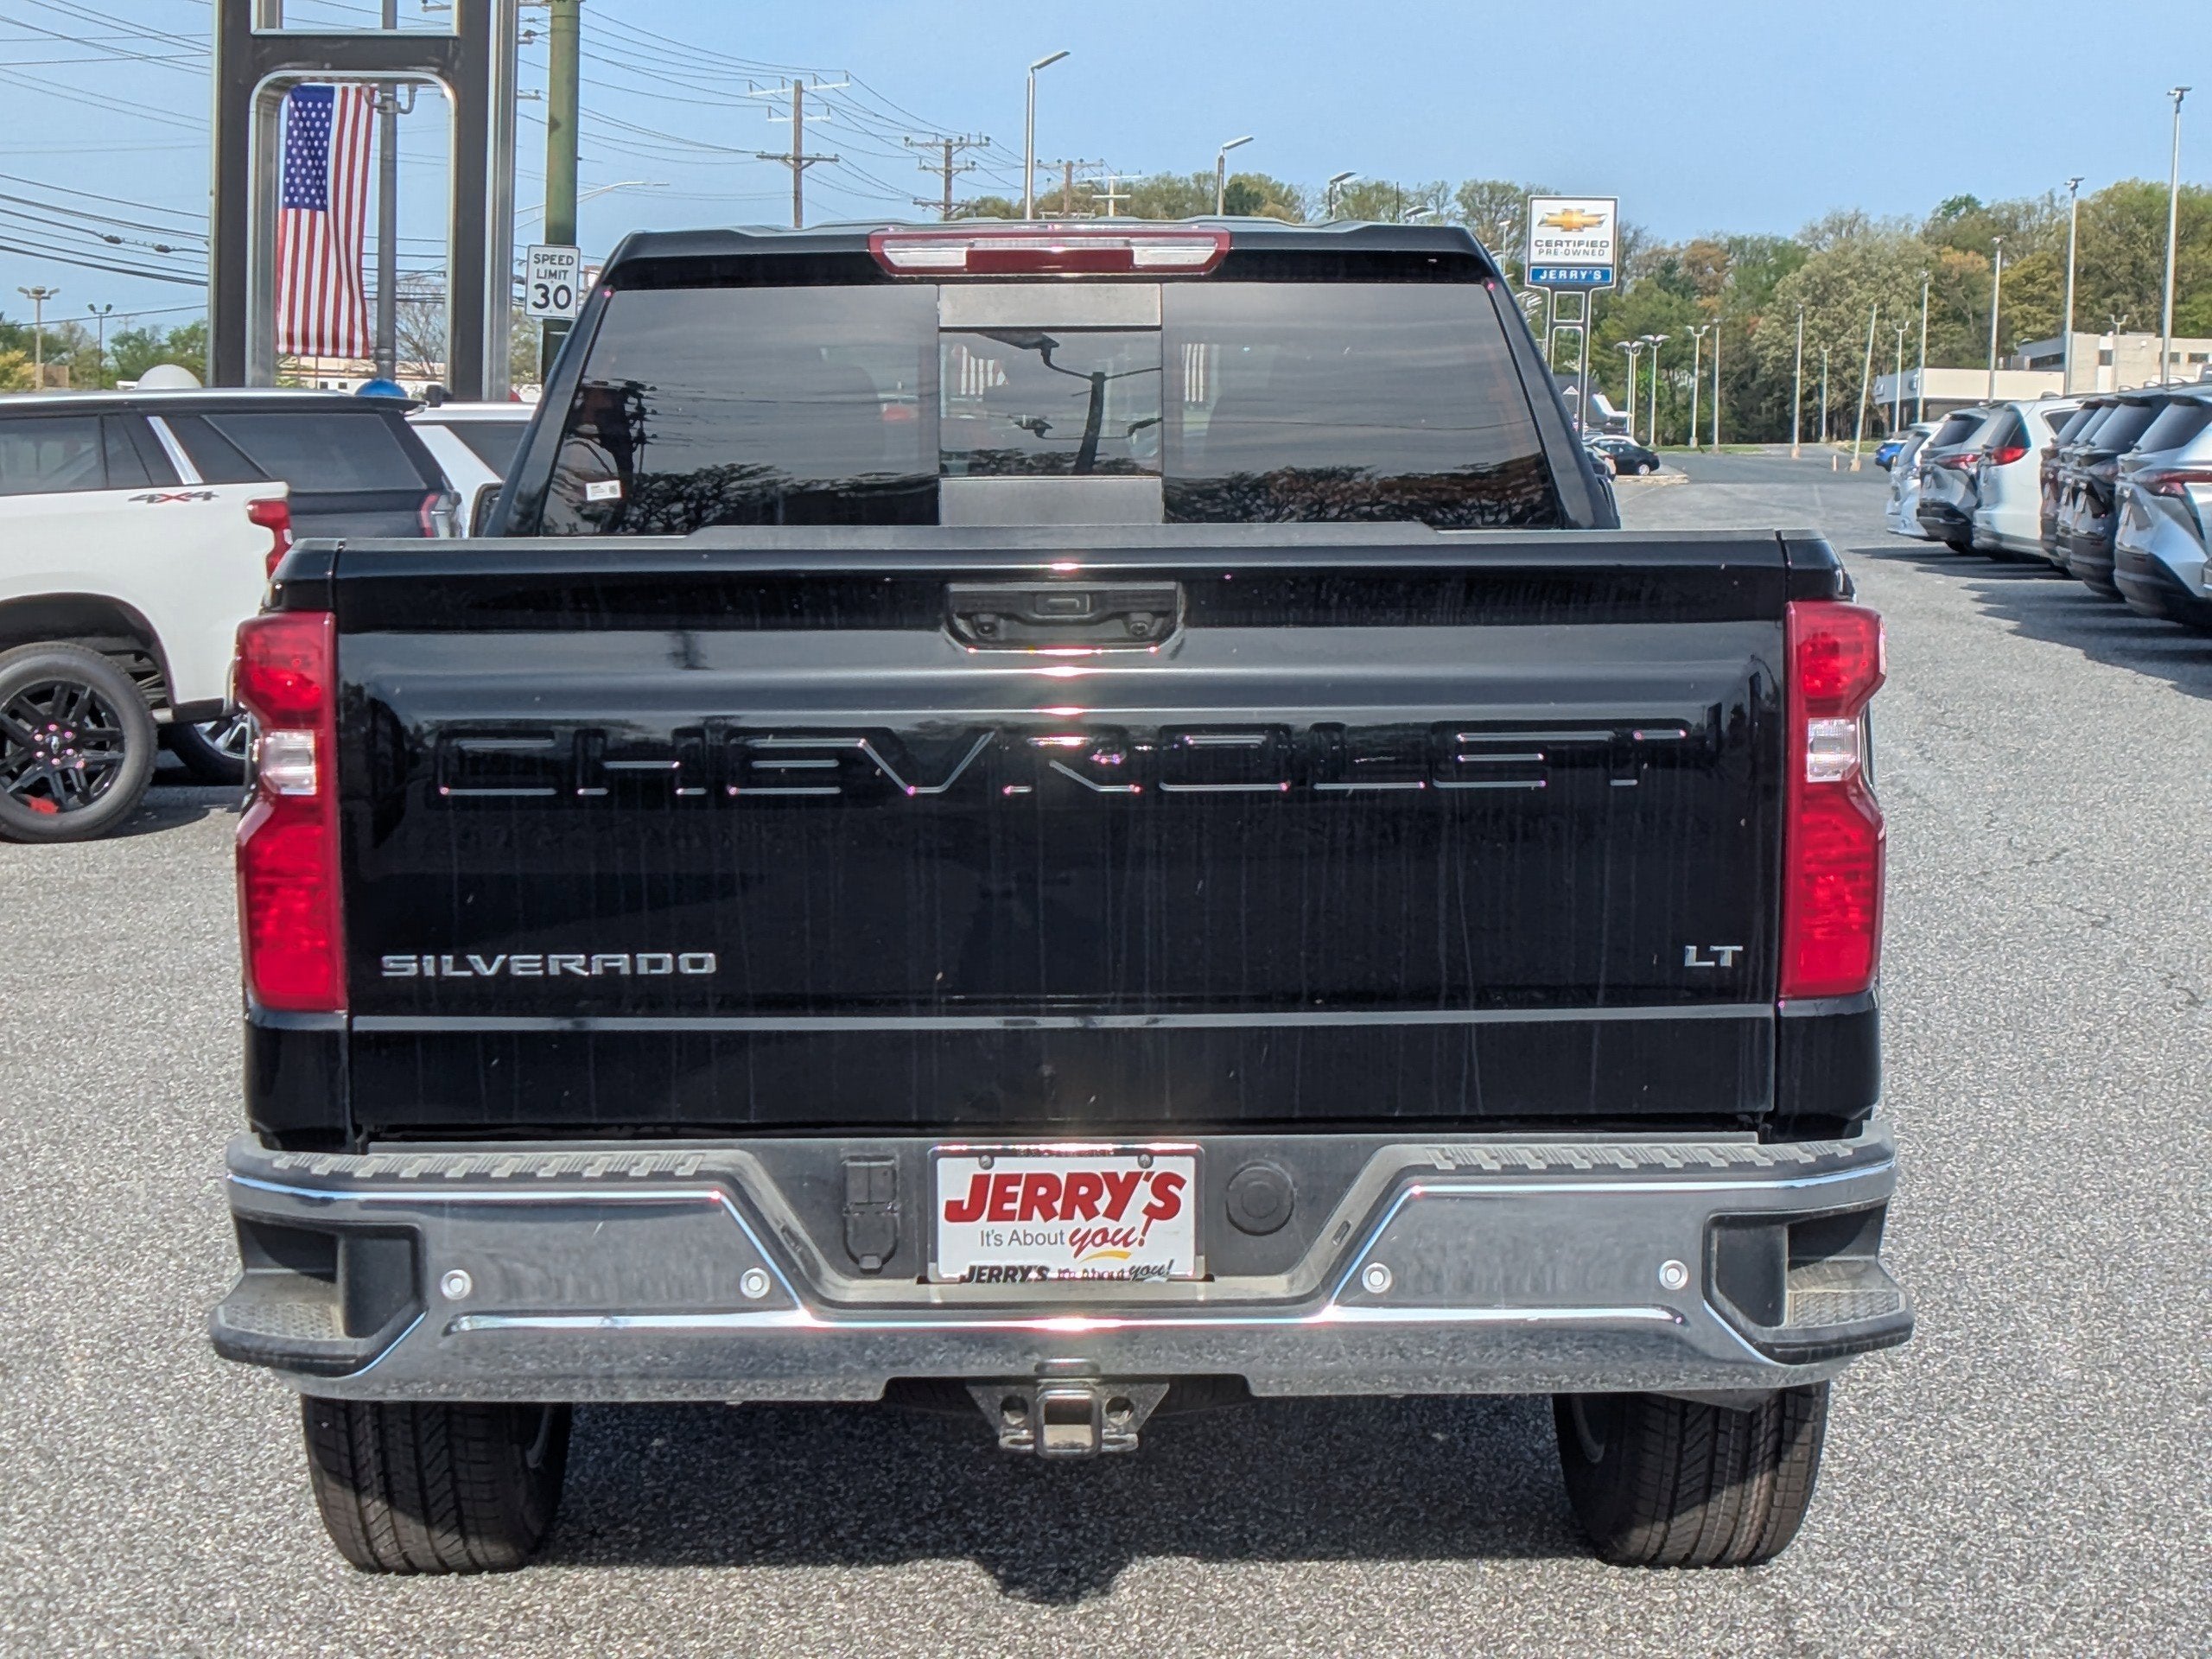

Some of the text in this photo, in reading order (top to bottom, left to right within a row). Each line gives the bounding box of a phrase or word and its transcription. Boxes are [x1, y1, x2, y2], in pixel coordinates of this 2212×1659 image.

[1535, 239, 1610, 248] CERTIFIED
[1538, 248, 1605, 257] PRE-OWNED
[533, 253, 574, 266] SPEED
[537, 269, 569, 280] LIMIT
[1539, 270, 1602, 280] JERRY'S
[531, 283, 572, 309] 30
[381, 952, 716, 977] SILVERADO
[1684, 945, 1744, 967] LT
[944, 1171, 1187, 1223] JERRY'S
[981, 1217, 1154, 1259] It's About you!
[959, 1265, 1051, 1284] JERRY'S
